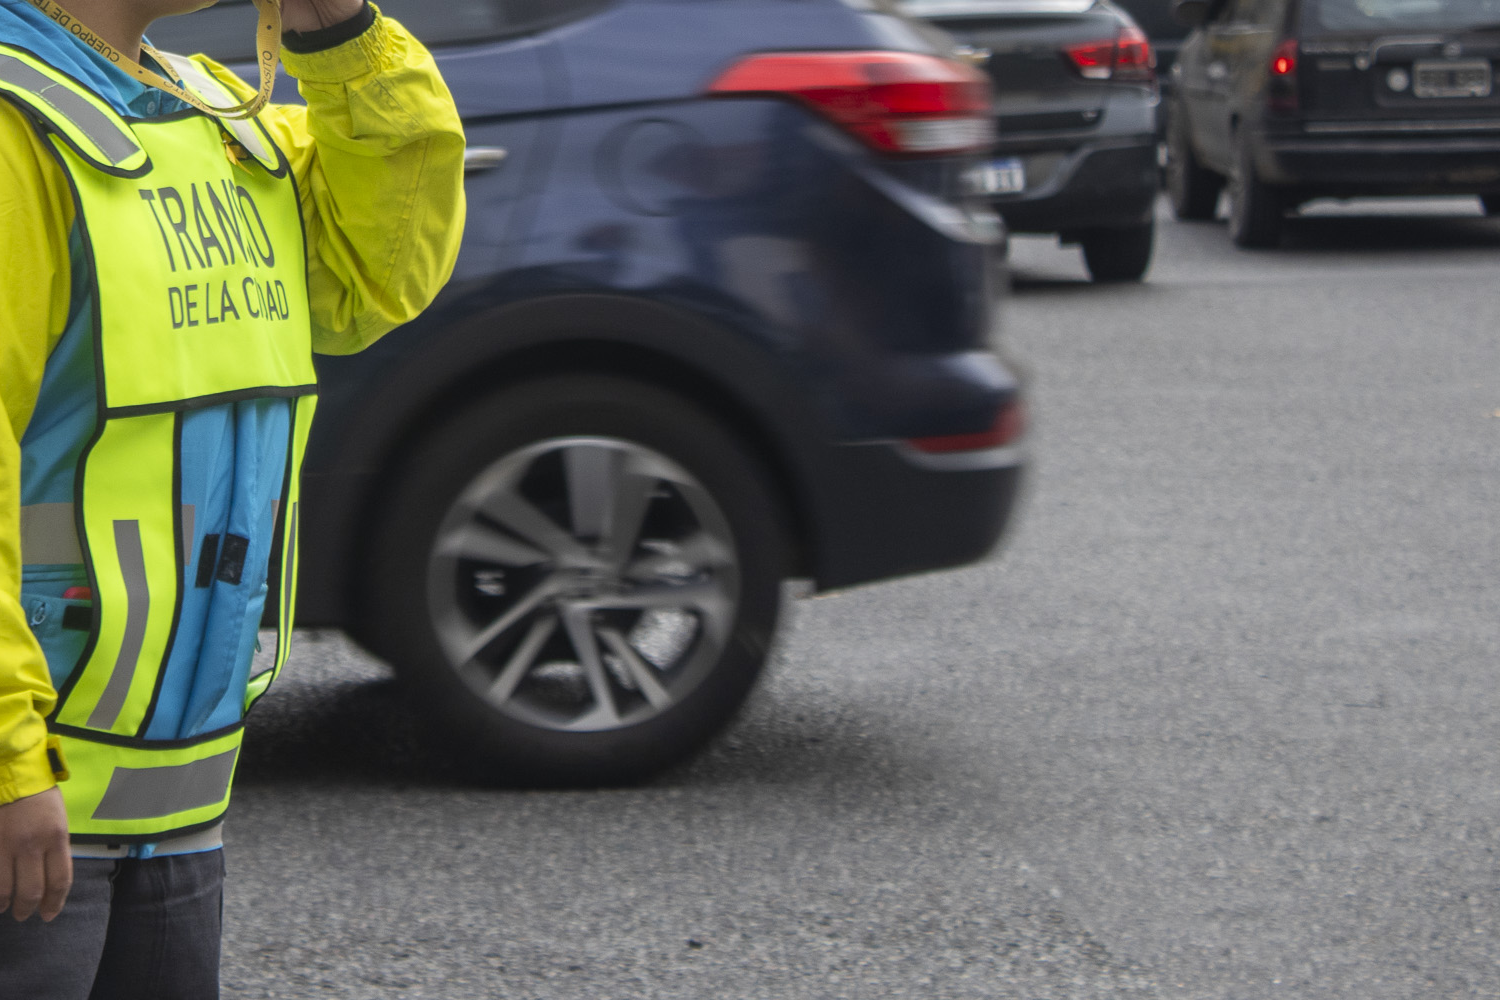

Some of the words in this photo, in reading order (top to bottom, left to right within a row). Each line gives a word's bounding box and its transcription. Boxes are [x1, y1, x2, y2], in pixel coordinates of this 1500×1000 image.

[50, 6, 71, 29] DE
[70, 23, 120, 63] CUERPO
[168, 284, 199, 329] DE
[206, 280, 241, 325] LA
